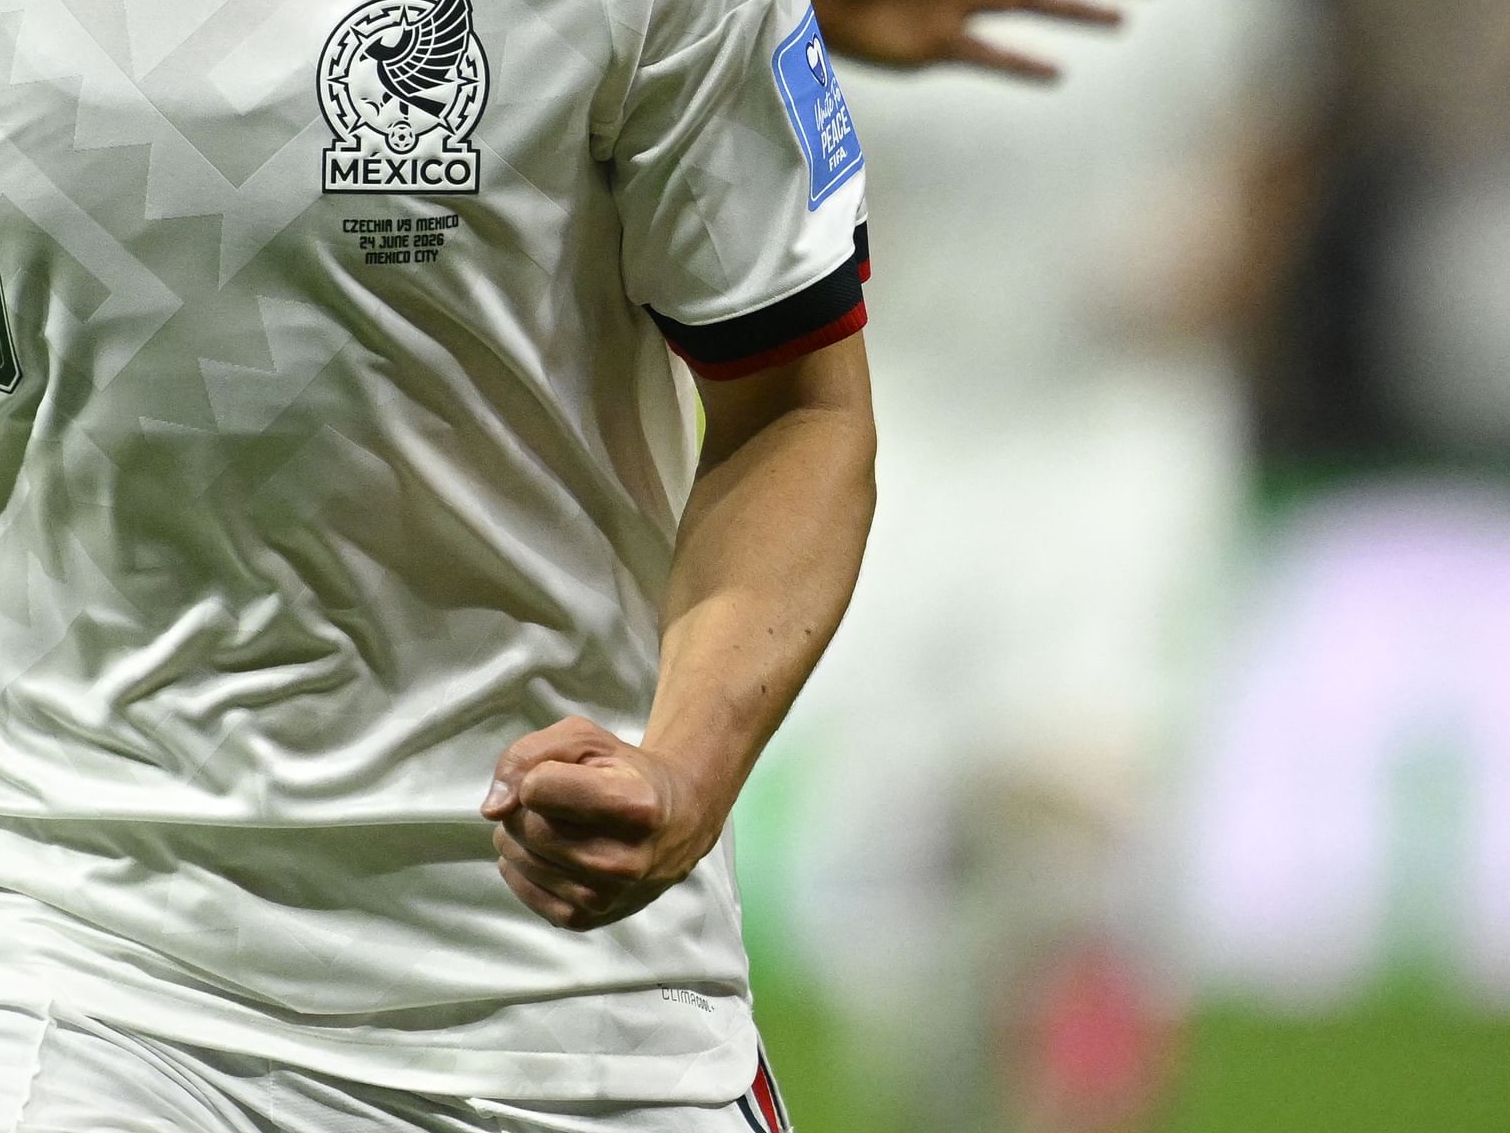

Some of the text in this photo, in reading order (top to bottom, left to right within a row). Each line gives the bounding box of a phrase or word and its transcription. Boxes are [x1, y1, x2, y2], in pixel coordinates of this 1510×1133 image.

[814, 90, 835, 131] Unite
[821, 107, 851, 159] PEACE
[330, 151, 471, 185] MÉXICO
[829, 146, 847, 172] FIFA
[343, 214, 459, 233] CZECHIA VS MEXICO
[359, 233, 444, 249] 24 JUNE 2026
[365, 250, 438, 265] MEXICO CITY
